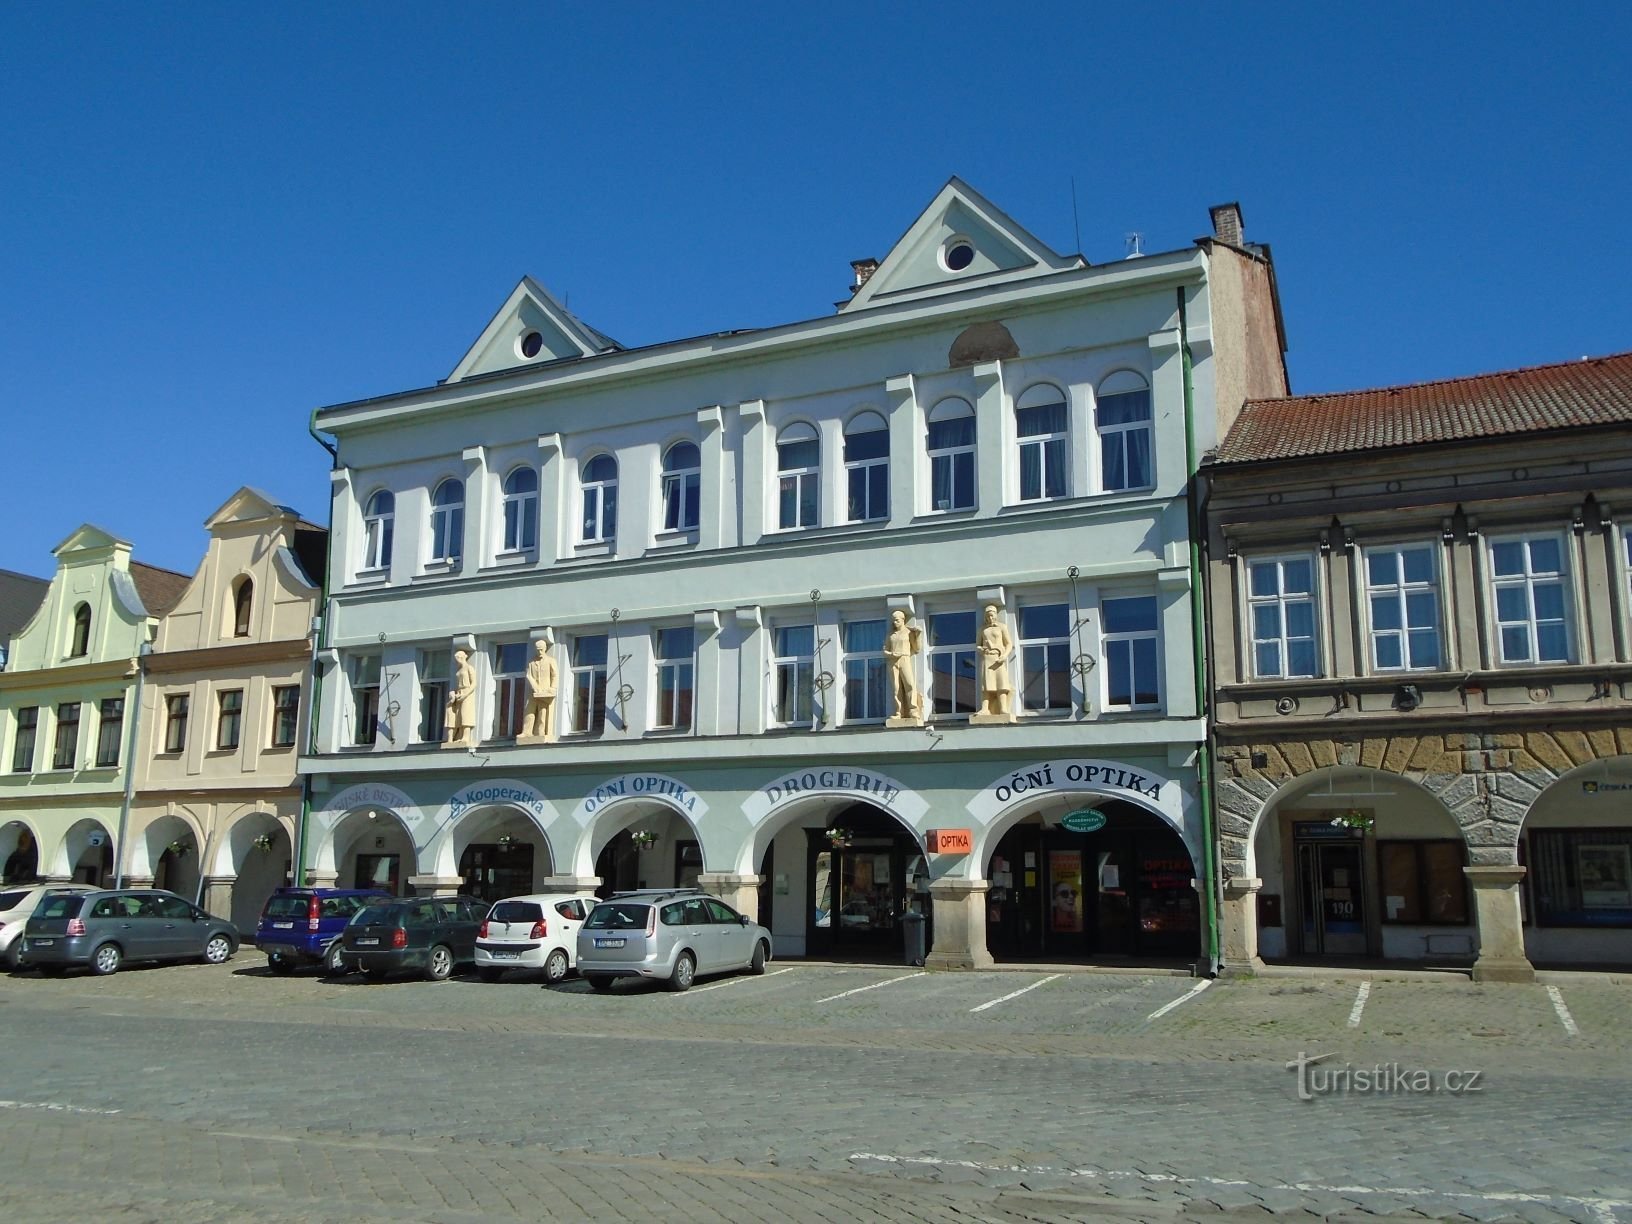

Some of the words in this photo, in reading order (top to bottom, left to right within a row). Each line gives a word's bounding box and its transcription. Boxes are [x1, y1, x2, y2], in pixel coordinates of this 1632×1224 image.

[584, 776, 626, 813] OČNÍ
[633, 776, 697, 812] OPTIKA
[765, 771, 901, 805] DROGERIE
[995, 763, 1055, 802] OČNÍ
[1065, 764, 1162, 802] OPTIKA
[466, 787, 545, 815] Kooperativa
[941, 835, 969, 848] OPTIKA
